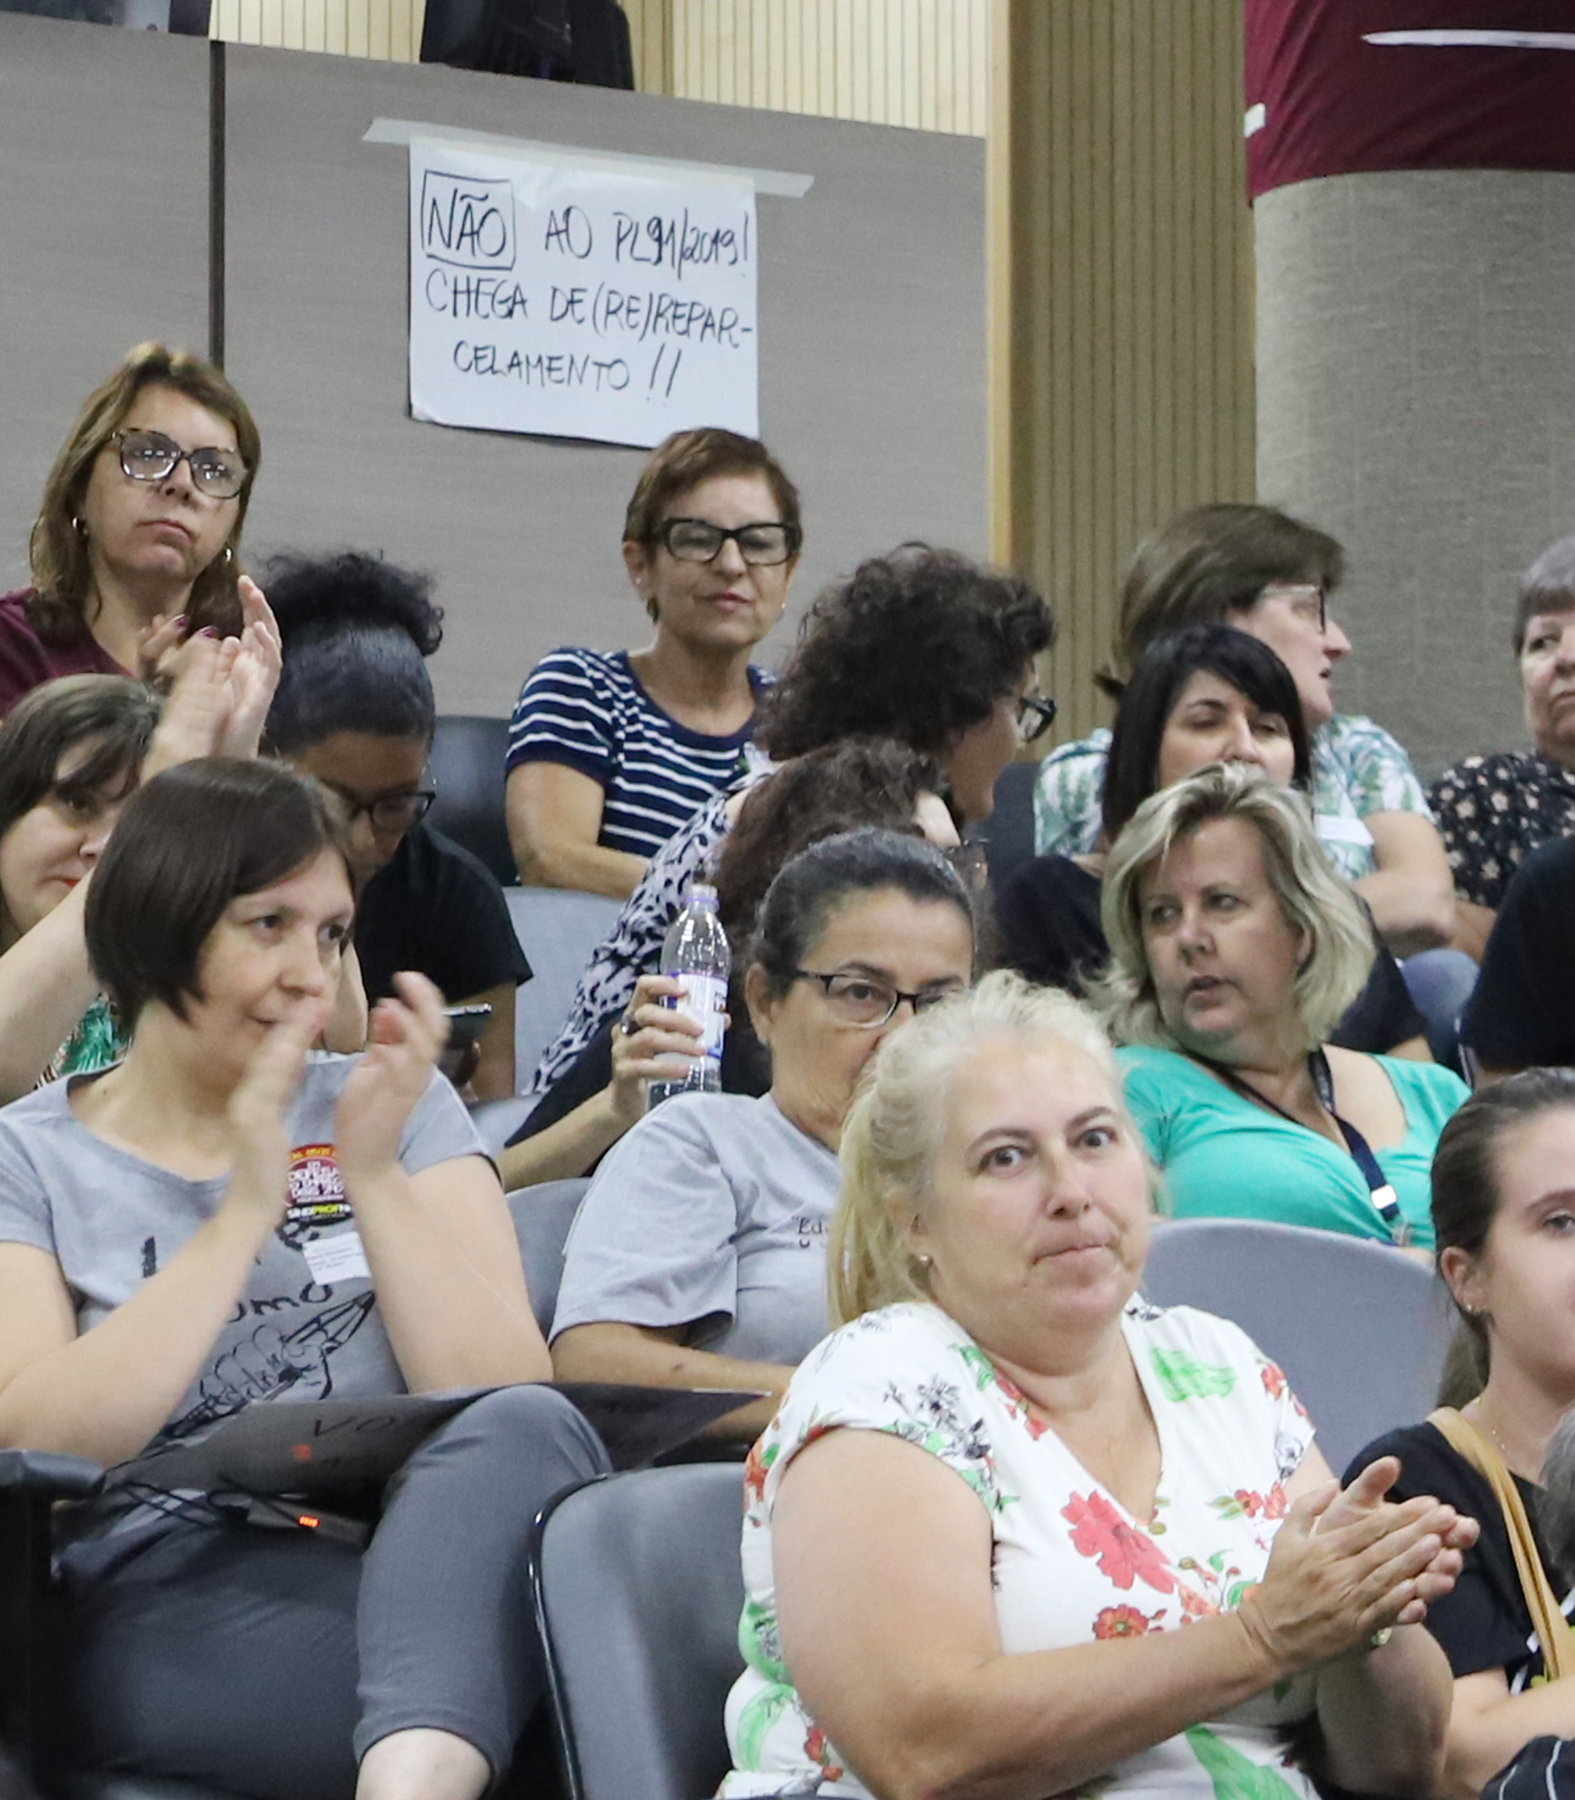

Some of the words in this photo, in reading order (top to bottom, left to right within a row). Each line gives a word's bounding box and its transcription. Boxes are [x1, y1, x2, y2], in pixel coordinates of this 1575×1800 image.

[425, 186, 507, 258] NÃO
[543, 204, 593, 259] AO
[425, 268, 528, 321] CHEGA
